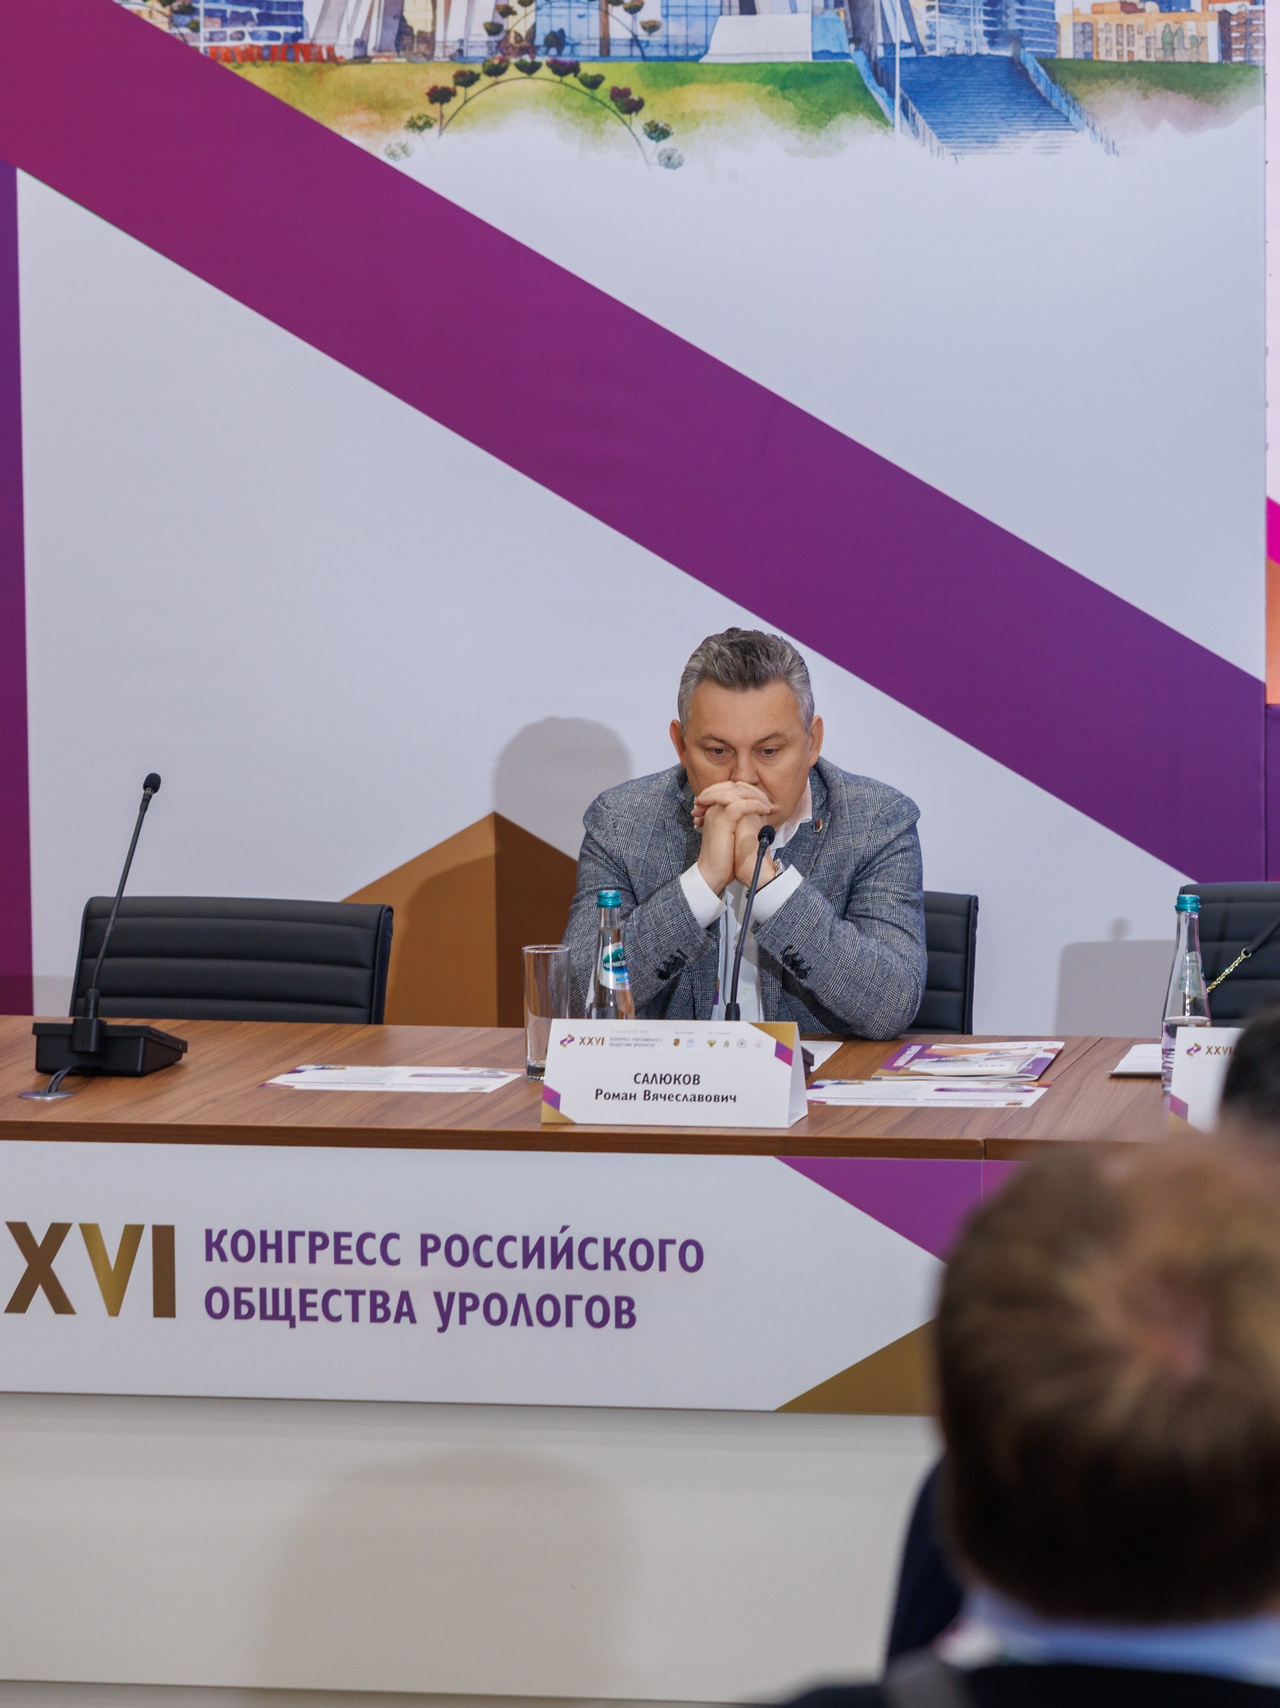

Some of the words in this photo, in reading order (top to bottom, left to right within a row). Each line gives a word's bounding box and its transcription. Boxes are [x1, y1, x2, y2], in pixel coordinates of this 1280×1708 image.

[578, 1036, 605, 1047] XXVI
[633, 1072, 701, 1086] САЛЮКОВ
[594, 1088, 638, 1101] Роман
[643, 1089, 737, 1104] Вячеславович
[204, 1228, 401, 1267] КОНГРЕСС
[420, 1225, 705, 1273] РОССИЙСКОГО
[204, 1286, 418, 1328] ОБЩЕСТВА
[432, 1290, 638, 1334] УРОЛОГОВ
